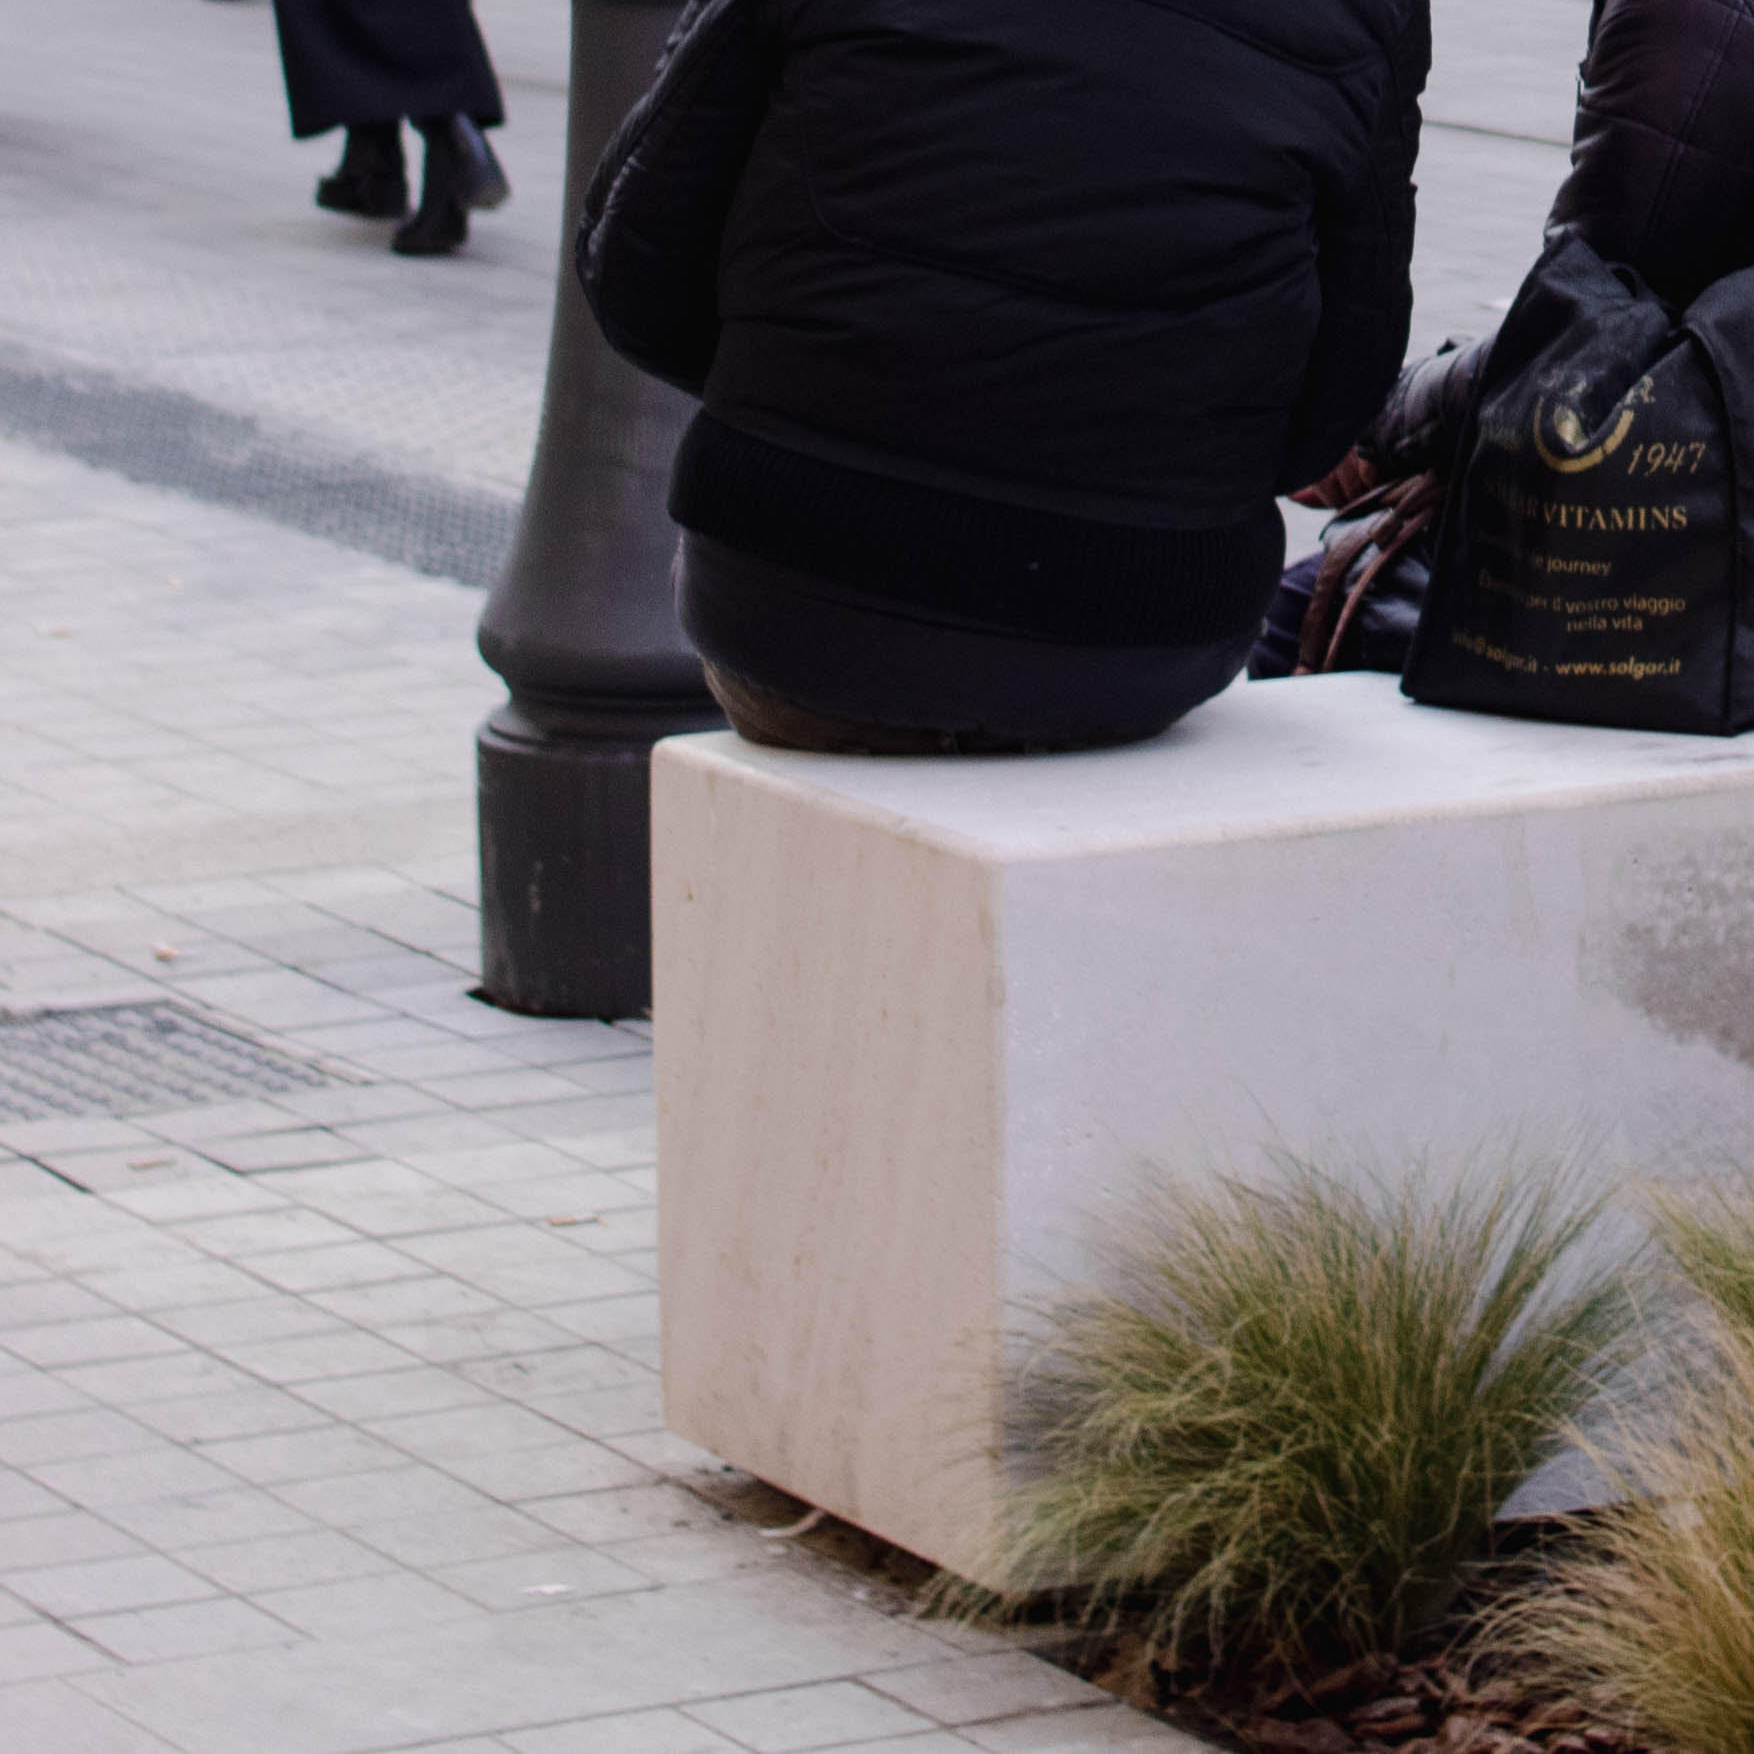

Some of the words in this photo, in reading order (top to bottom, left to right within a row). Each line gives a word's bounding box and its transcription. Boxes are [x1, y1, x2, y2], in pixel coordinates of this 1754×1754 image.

[1627, 441, 1706, 476] 1947
[1543, 502, 1688, 531] VITAMINS
[1546, 555, 1612, 579] journey
[1623, 592, 1687, 617] viaggio
[1610, 614, 1644, 632] vita
[1555, 655, 1682, 682] www.solgar.it
